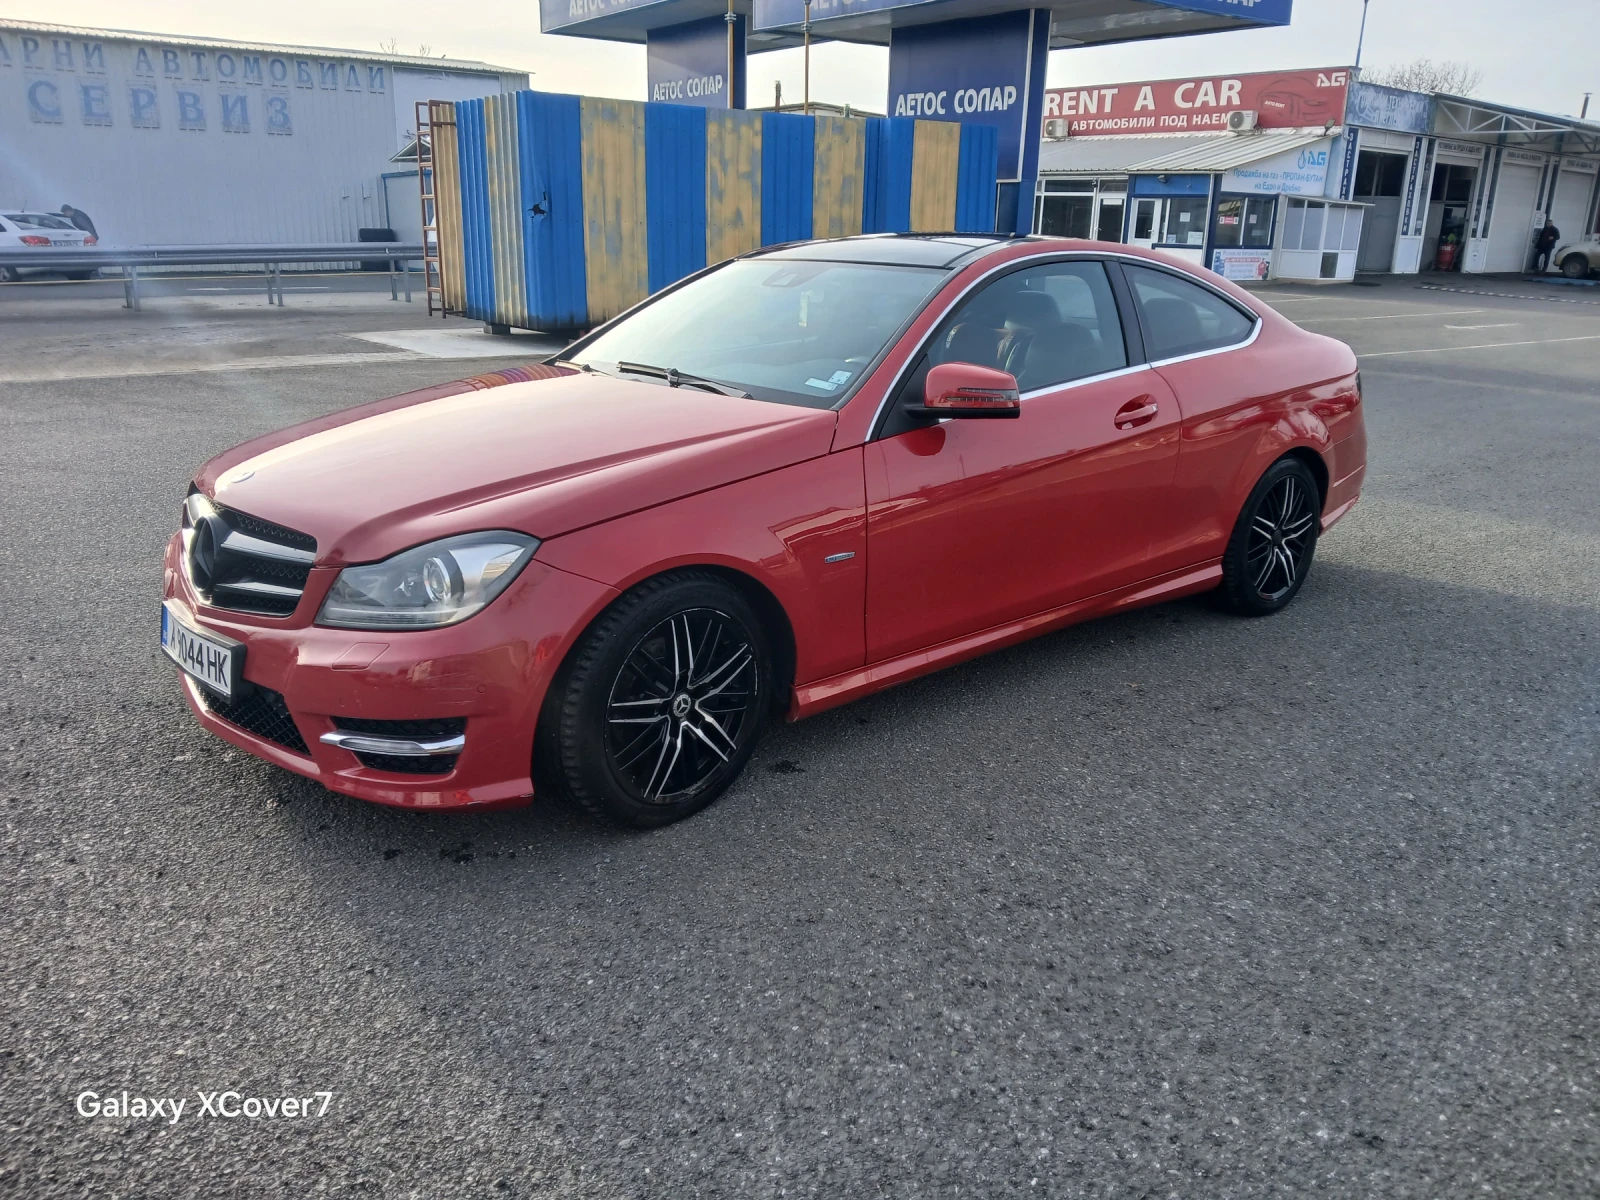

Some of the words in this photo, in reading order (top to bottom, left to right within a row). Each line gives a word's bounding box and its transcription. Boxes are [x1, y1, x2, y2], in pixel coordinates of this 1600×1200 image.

[135, 47, 385, 90] АВТОМОБИЛИ
[28, 80, 291, 128] СЕРВИЗ
[653, 80, 683, 102] АЕТОС
[894, 90, 947, 117] АЕТОС
[1043, 88, 1119, 117] RENT
[1134, 86, 1155, 112] A
[1174, 79, 1242, 109] CAR
[1071, 116, 1155, 131] АВТОМОБИЛИ
[1160, 114, 1187, 128] ПОД
[1192, 112, 1230, 125] НАЕМ
[1233, 168, 1262, 178] Продажба
[206, 645, 228, 688] HK
